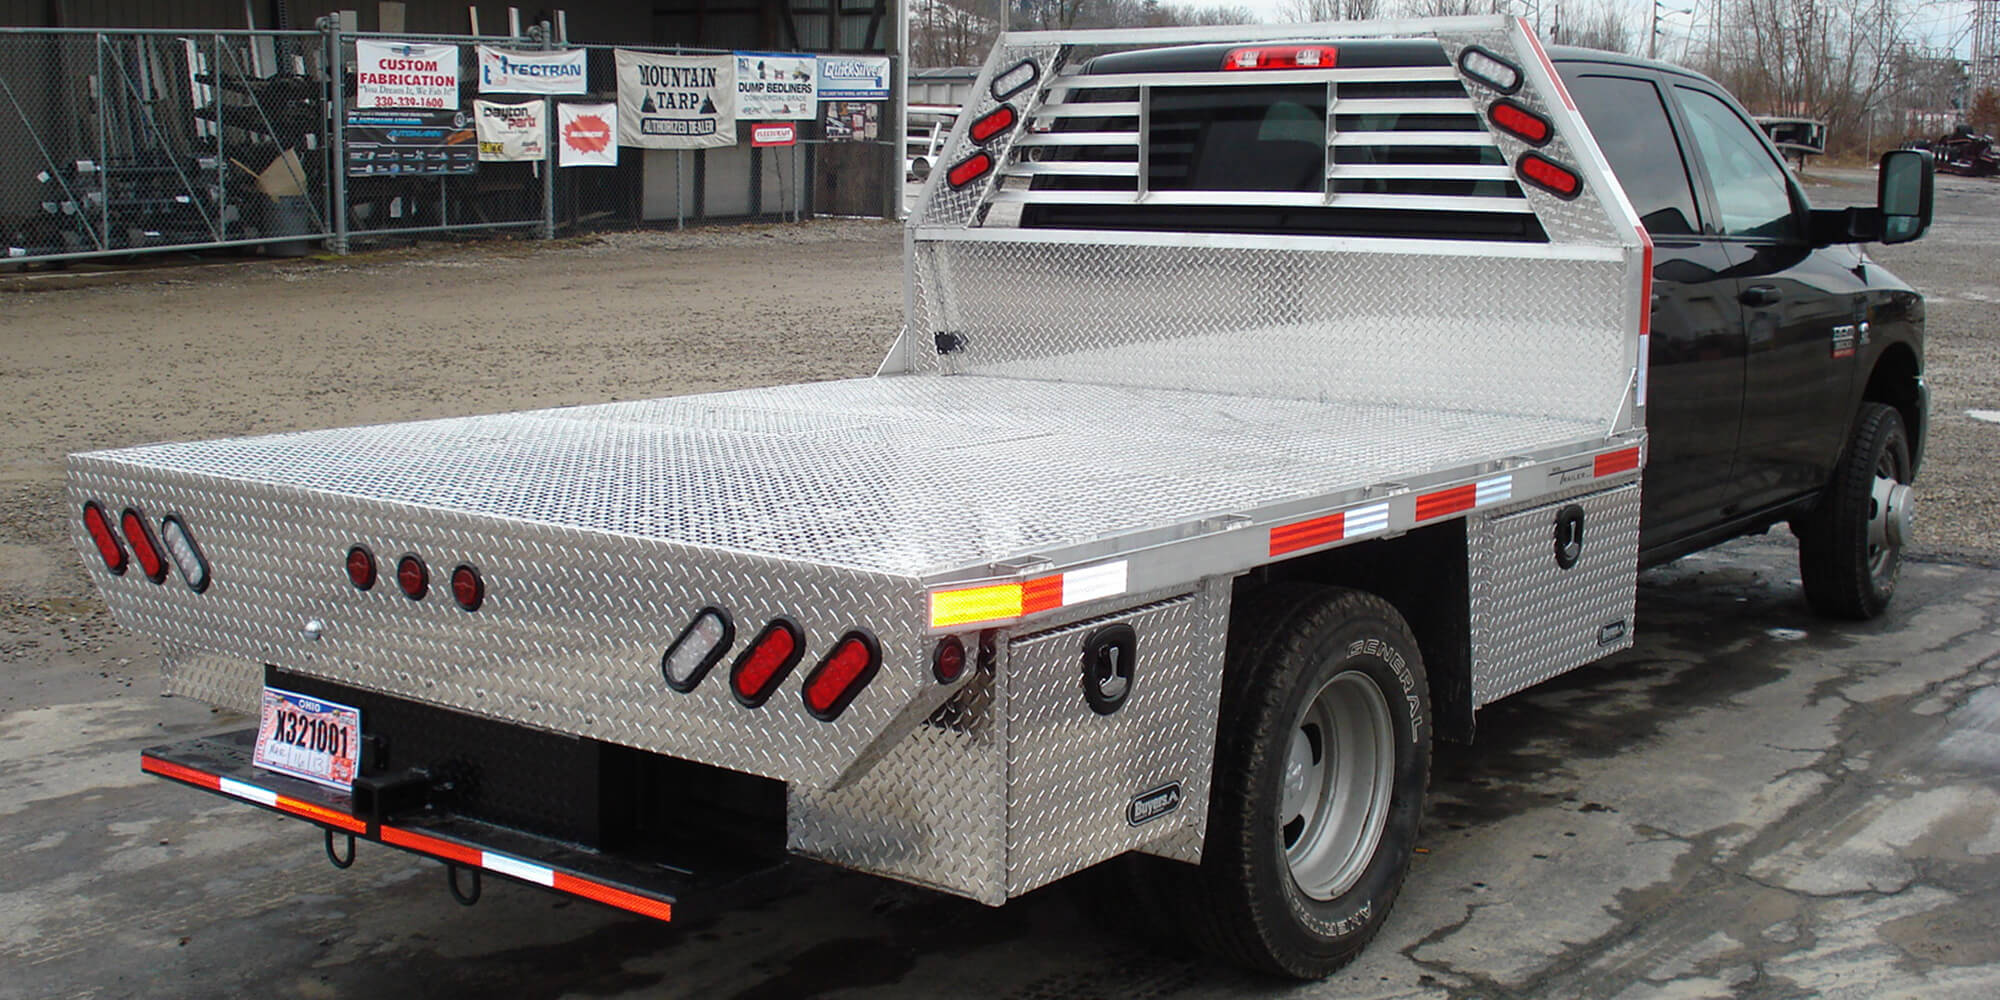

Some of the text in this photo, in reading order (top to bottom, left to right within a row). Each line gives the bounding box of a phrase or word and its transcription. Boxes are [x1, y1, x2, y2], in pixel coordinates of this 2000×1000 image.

[378, 59, 438, 71] CUSTOM
[508, 64, 581, 76] TECTRAN
[360, 73, 455, 86] FABRICATION
[638, 64, 717, 87] MOUNTAIN
[416, 87, 427, 95] We
[738, 82, 764, 93] DUMP
[766, 82, 812, 94] BEDLINERS
[374, 96, 444, 107] 330-339-1600
[656, 92, 699, 110] TARP
[483, 107, 528, 121] Dayton
[643, 120, 714, 134] AUTHORIZED DEALER
[1346, 639, 1423, 743] GENERAL
[298, 699, 321, 713] OHIO
[274, 709, 348, 758] X321001
[1134, 794, 1168, 816] Buyers
